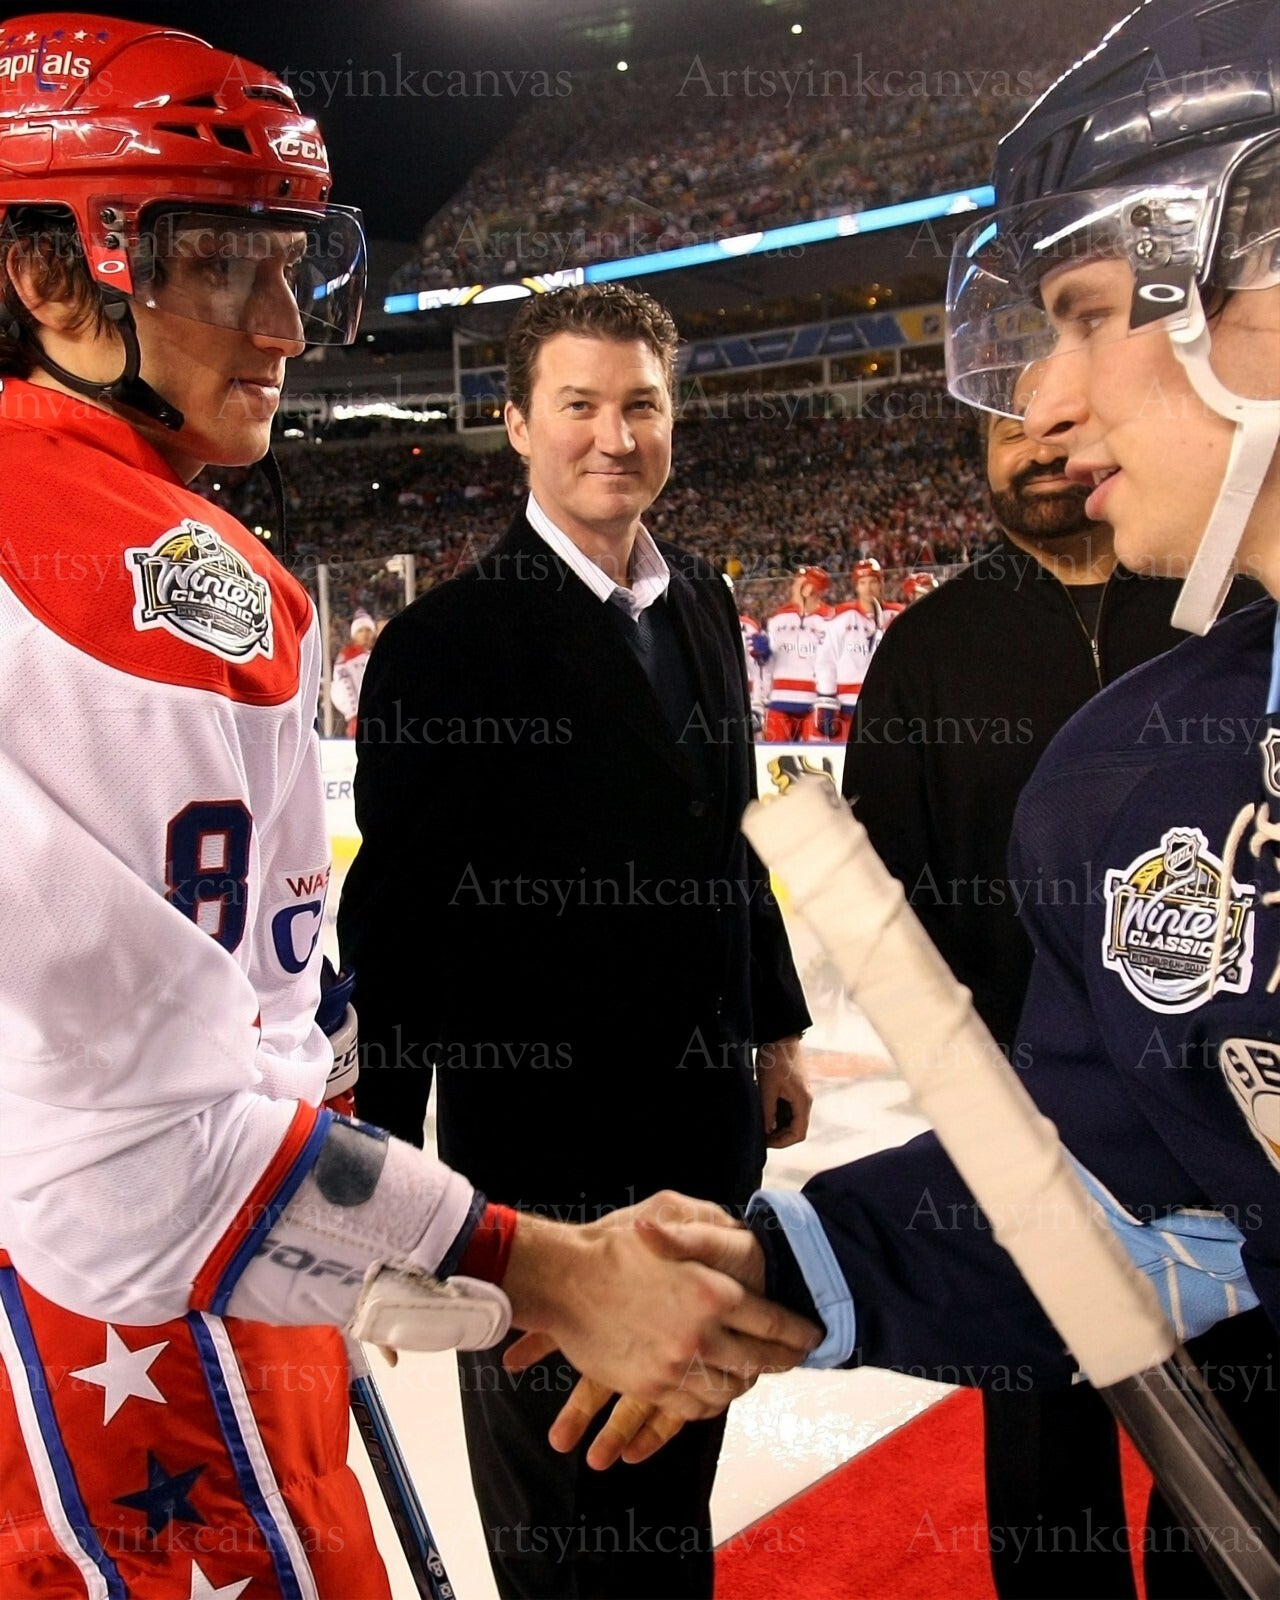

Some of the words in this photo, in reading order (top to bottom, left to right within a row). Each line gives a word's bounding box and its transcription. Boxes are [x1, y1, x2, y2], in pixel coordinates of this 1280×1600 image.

[143, 557, 261, 614] Winter
[170, 589, 254, 621] CLASSIC
[165, 799, 253, 954] 8
[1128, 929, 1216, 958] CLASSIC
